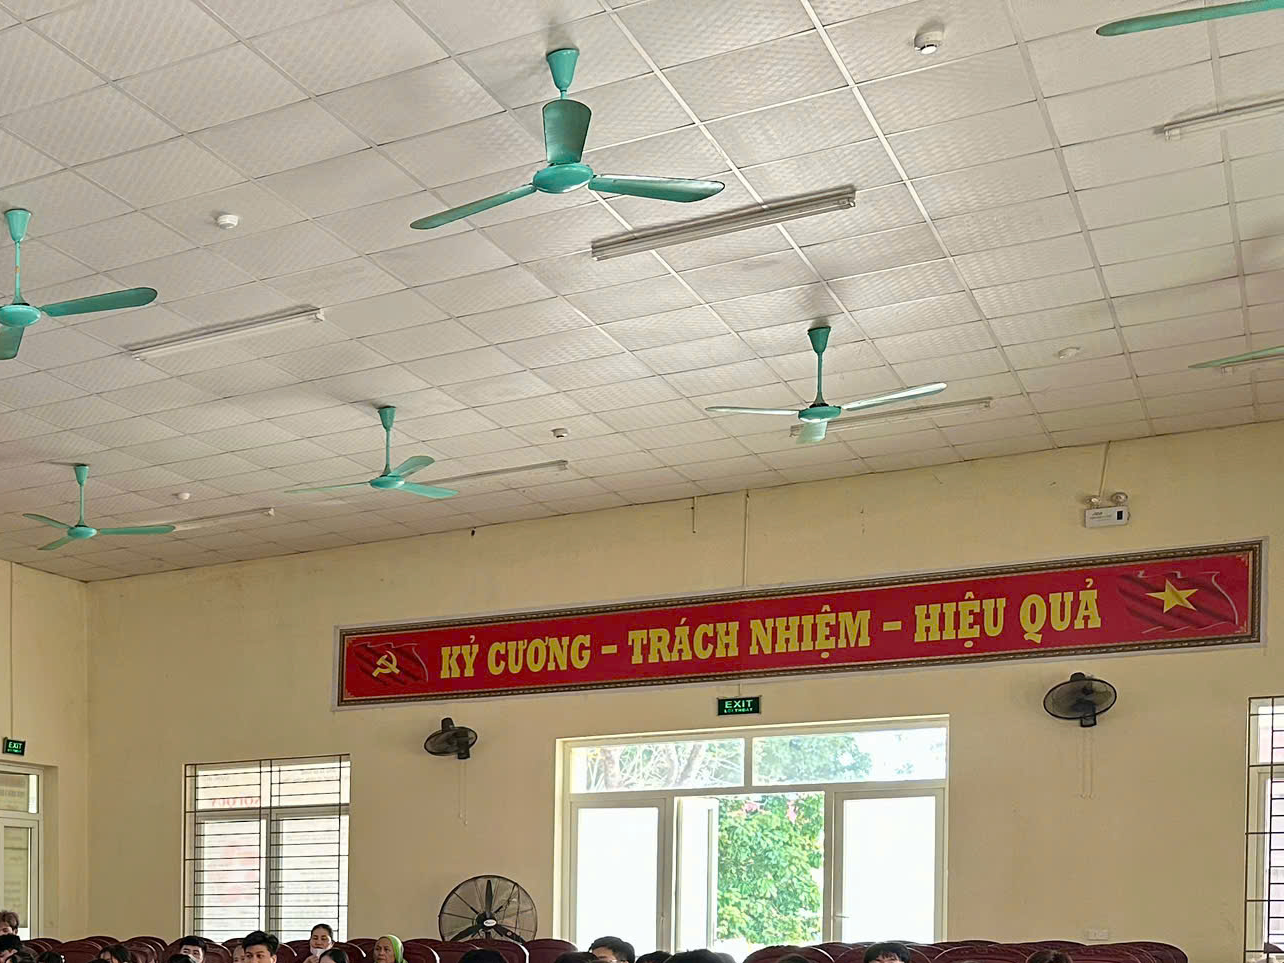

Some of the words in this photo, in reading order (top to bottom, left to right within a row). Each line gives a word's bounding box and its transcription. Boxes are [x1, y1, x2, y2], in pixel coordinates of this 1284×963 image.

[440, 634, 479, 679] KỶ
[487, 635, 591, 675] CƯƠNG
[627, 617, 739, 665] TRÁCH
[749, 604, 871, 659] NHIỆM
[914, 591, 1006, 648] HIỆU
[1019, 578, 1101, 644] QUẢ
[724, 699, 753, 708] EXIT
